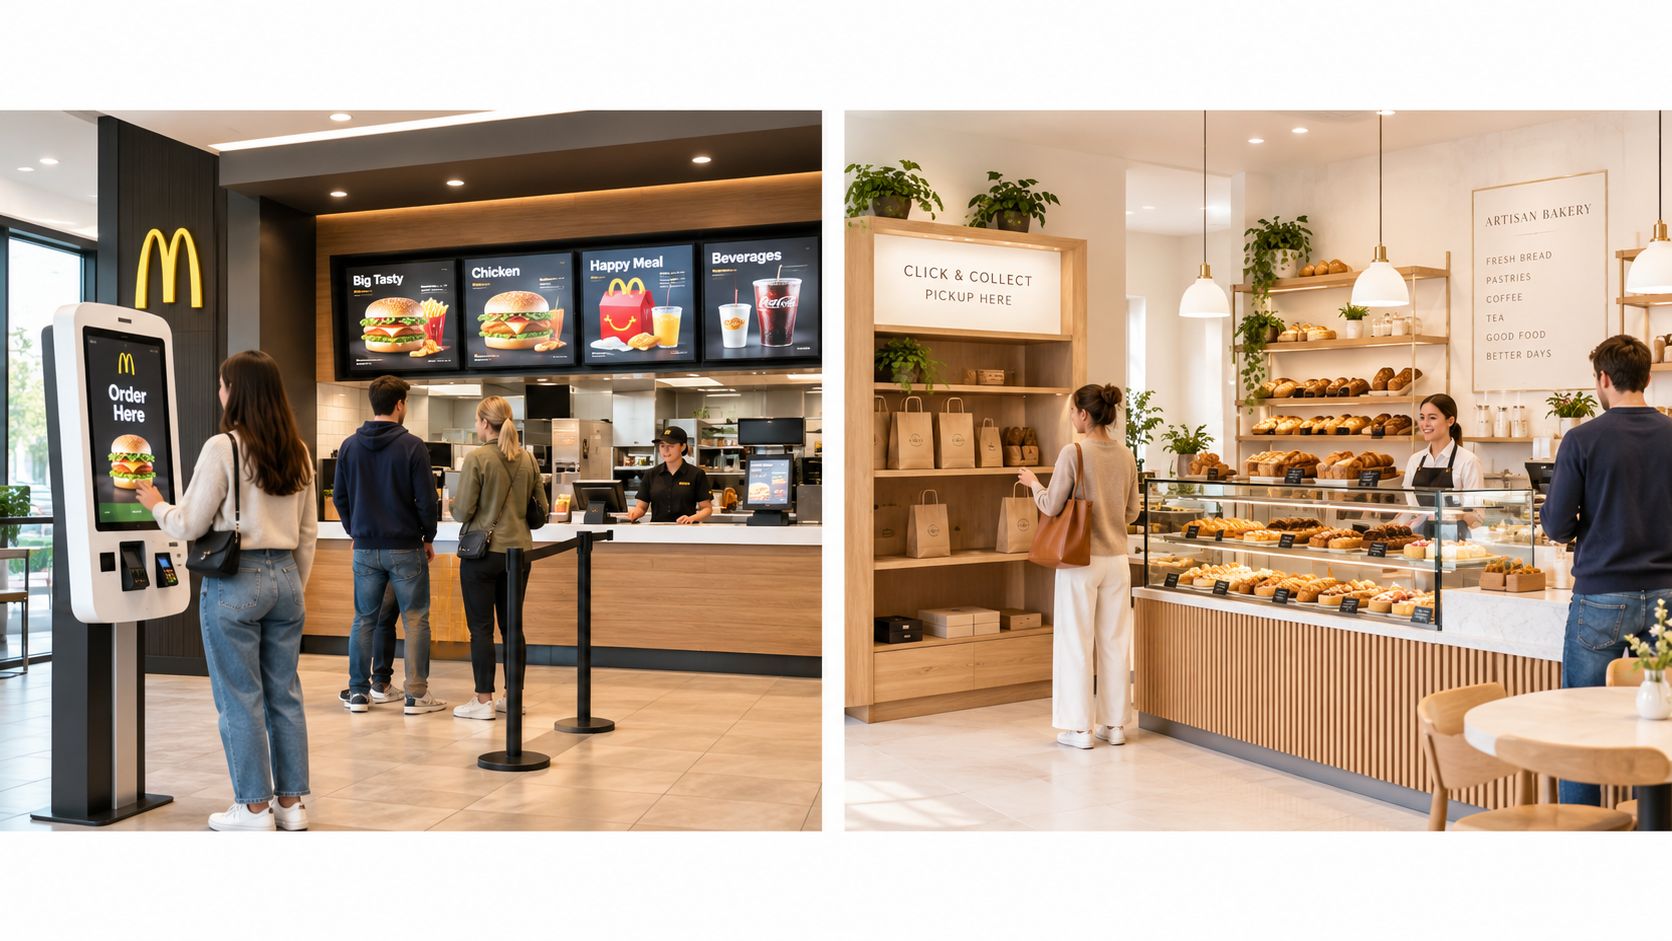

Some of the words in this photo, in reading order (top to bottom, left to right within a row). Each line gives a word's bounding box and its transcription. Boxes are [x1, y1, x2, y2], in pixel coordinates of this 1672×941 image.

[1485, 211, 1537, 228] ARTISAN
[1542, 203, 1592, 220] BAKERY
[590, 258, 630, 273] Happy
[633, 255, 663, 269] Meal
[711, 250, 782, 265] Beverages
[1486, 255, 1516, 266] FRESH
[1520, 251, 1552, 262] BREAD
[471, 265, 521, 279] Chicken
[903, 264, 948, 280] CLICK
[954, 269, 964, 281] &
[970, 271, 1032, 286] COLLECT
[1486, 272, 1532, 285] PASTRIES
[353, 275, 371, 288] Big
[374, 273, 404, 287] Tasty
[925, 288, 974, 303] PICKUP
[979, 293, 1012, 306] HERE
[1486, 293, 1523, 304] COFFEE
[1486, 313, 1505, 323] TEA
[1486, 331, 1514, 342] GOOD
[1518, 330, 1546, 340] FOOD
[1486, 350, 1522, 361] BETTER
[1526, 349, 1552, 359] DAYS
[109, 384, 146, 404] Order
[114, 404, 145, 423] Here
